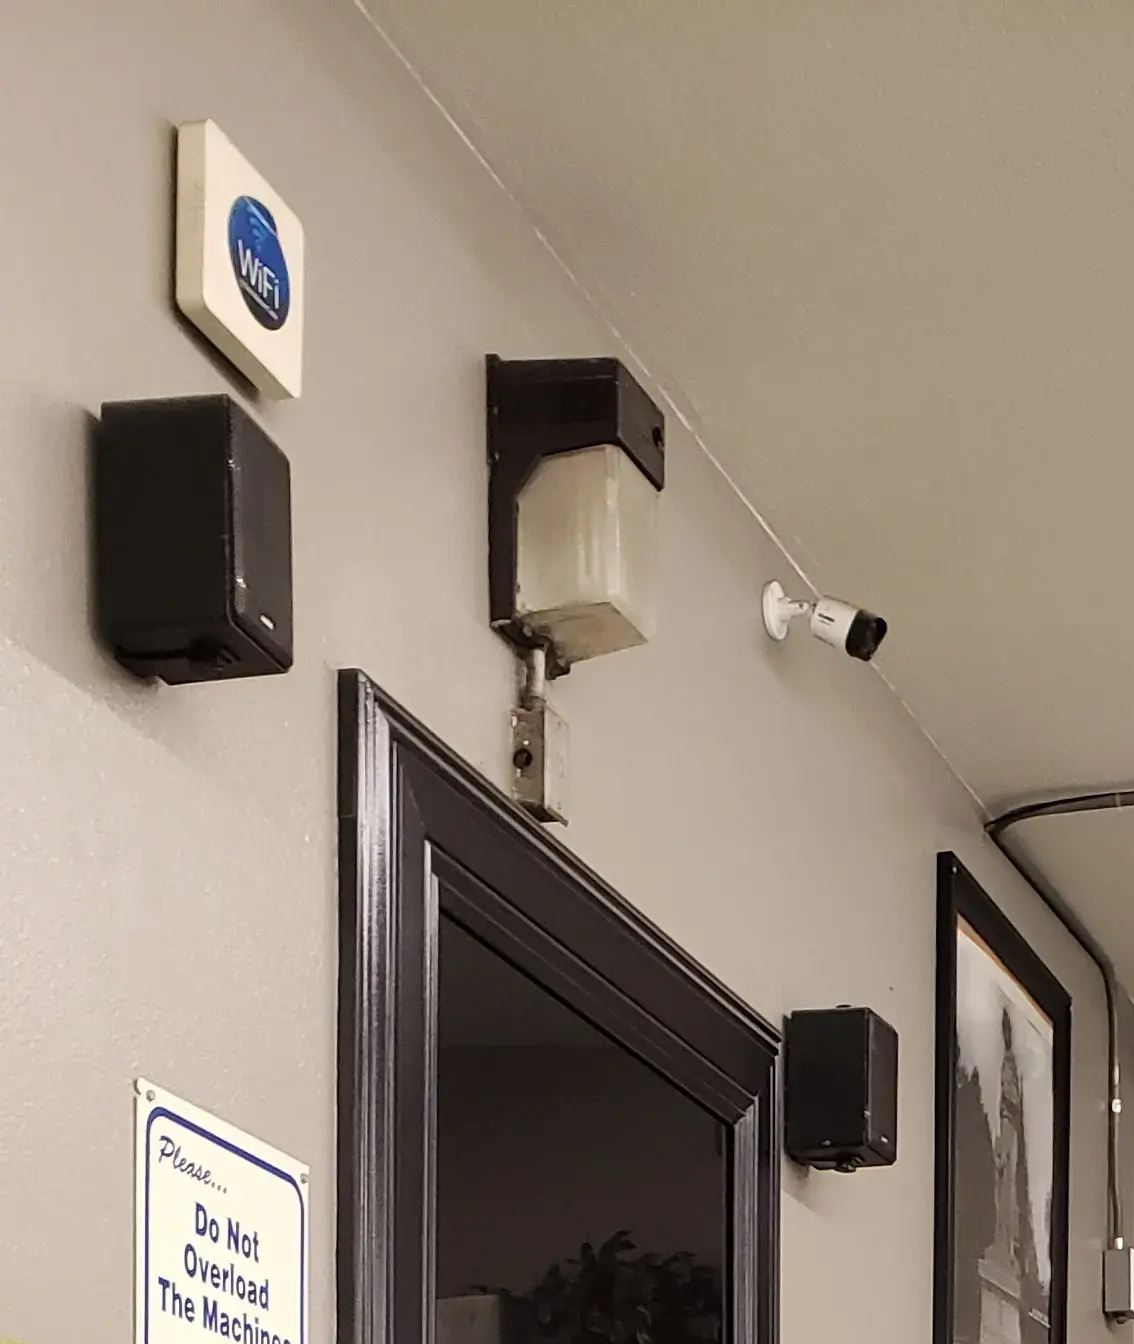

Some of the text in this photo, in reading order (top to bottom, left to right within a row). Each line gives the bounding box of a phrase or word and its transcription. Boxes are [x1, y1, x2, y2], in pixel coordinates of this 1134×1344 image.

[237, 239, 281, 309] WiFi
[195, 1202, 259, 1263] Do Not
[158, 1276, 195, 1323] The
[184, 1244, 269, 1311] Overload
